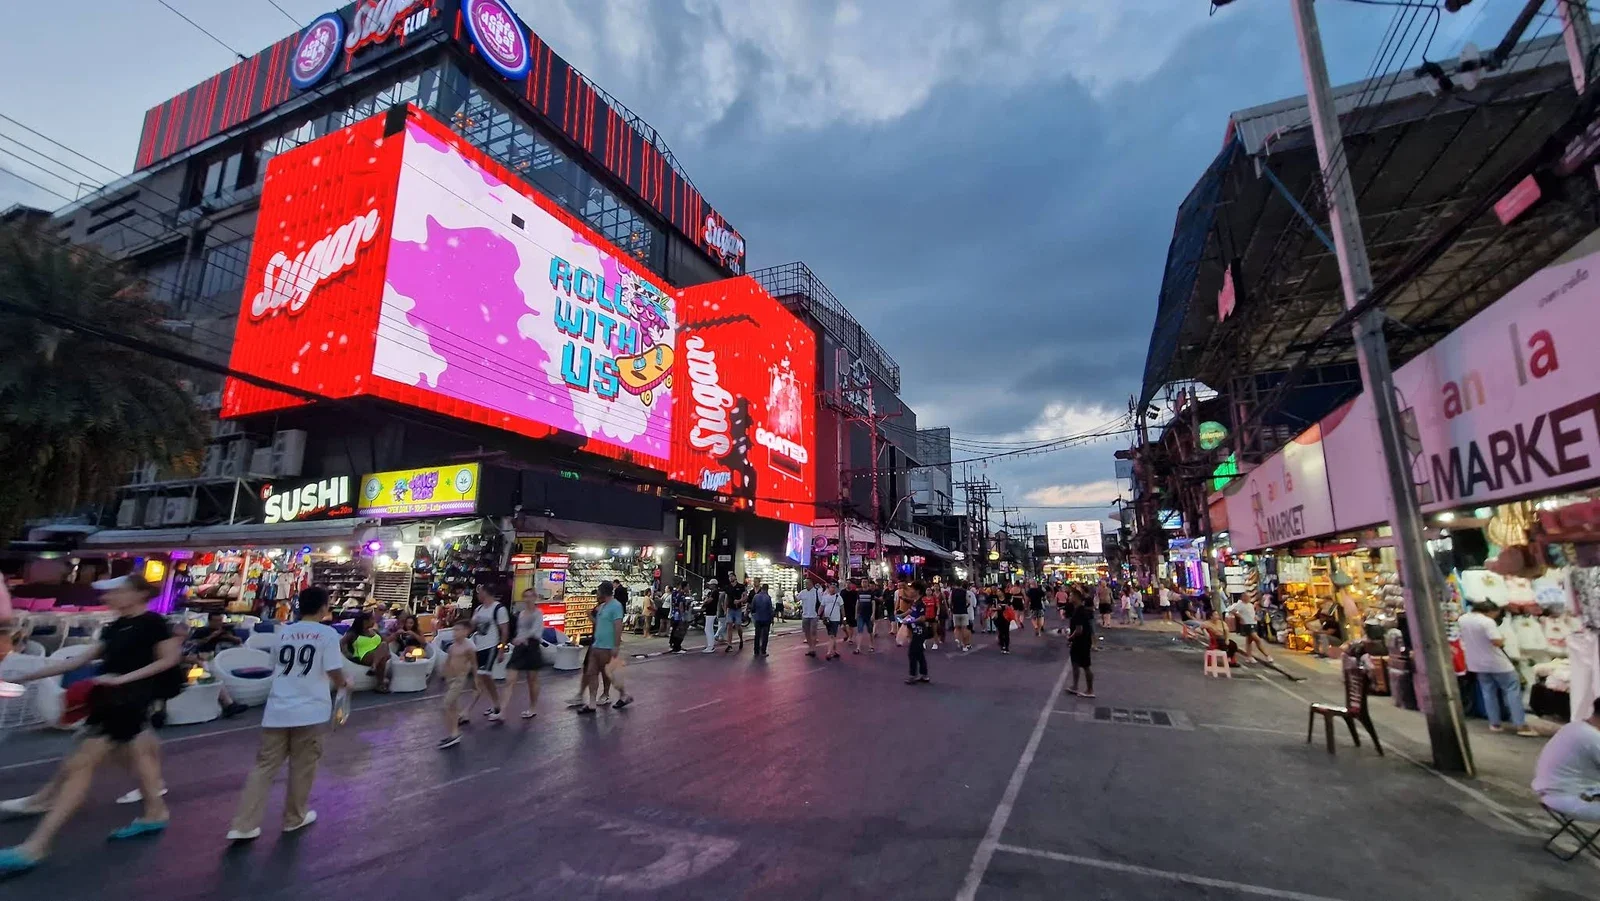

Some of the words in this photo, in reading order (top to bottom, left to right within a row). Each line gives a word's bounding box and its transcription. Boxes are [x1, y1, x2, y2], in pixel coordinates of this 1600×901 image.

[704, 215, 744, 257] Sugar
[251, 208, 381, 317] Sugar
[549, 254, 633, 320] ROLL
[554, 296, 638, 358] WITH
[560, 340, 621, 403] US
[685, 335, 734, 455] Sugar
[755, 427, 808, 464] GOATED
[263, 475, 350, 524] SUSHI
[701, 468, 731, 492] Sugar
[1267, 504, 1306, 542] MARKET
[279, 644, 316, 677] 99
